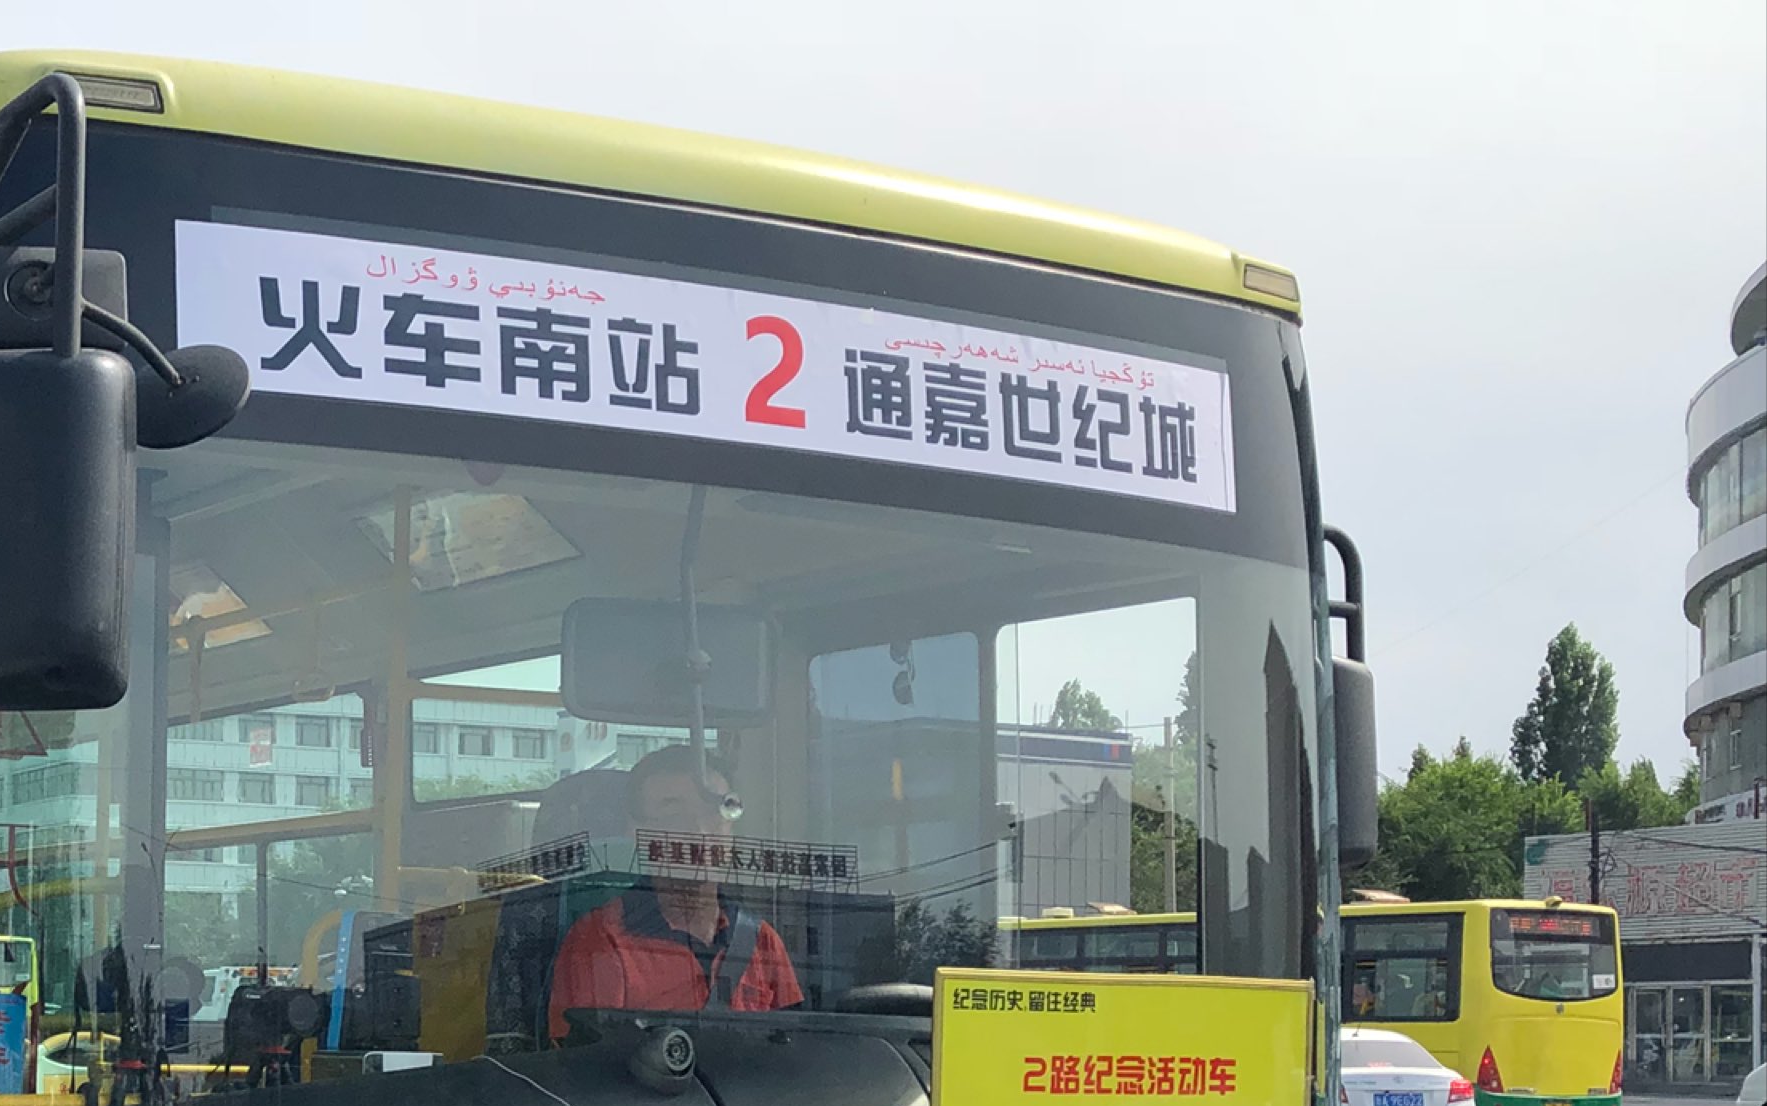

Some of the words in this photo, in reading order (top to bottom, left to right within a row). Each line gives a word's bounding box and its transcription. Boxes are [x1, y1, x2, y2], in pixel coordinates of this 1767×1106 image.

[258, 274, 703, 417] 火车南站
[742, 315, 808, 430] 2
[843, 347, 1200, 484] 通嘉世纪城
[1022, 1055, 1237, 1096] 2路纪念活动车
